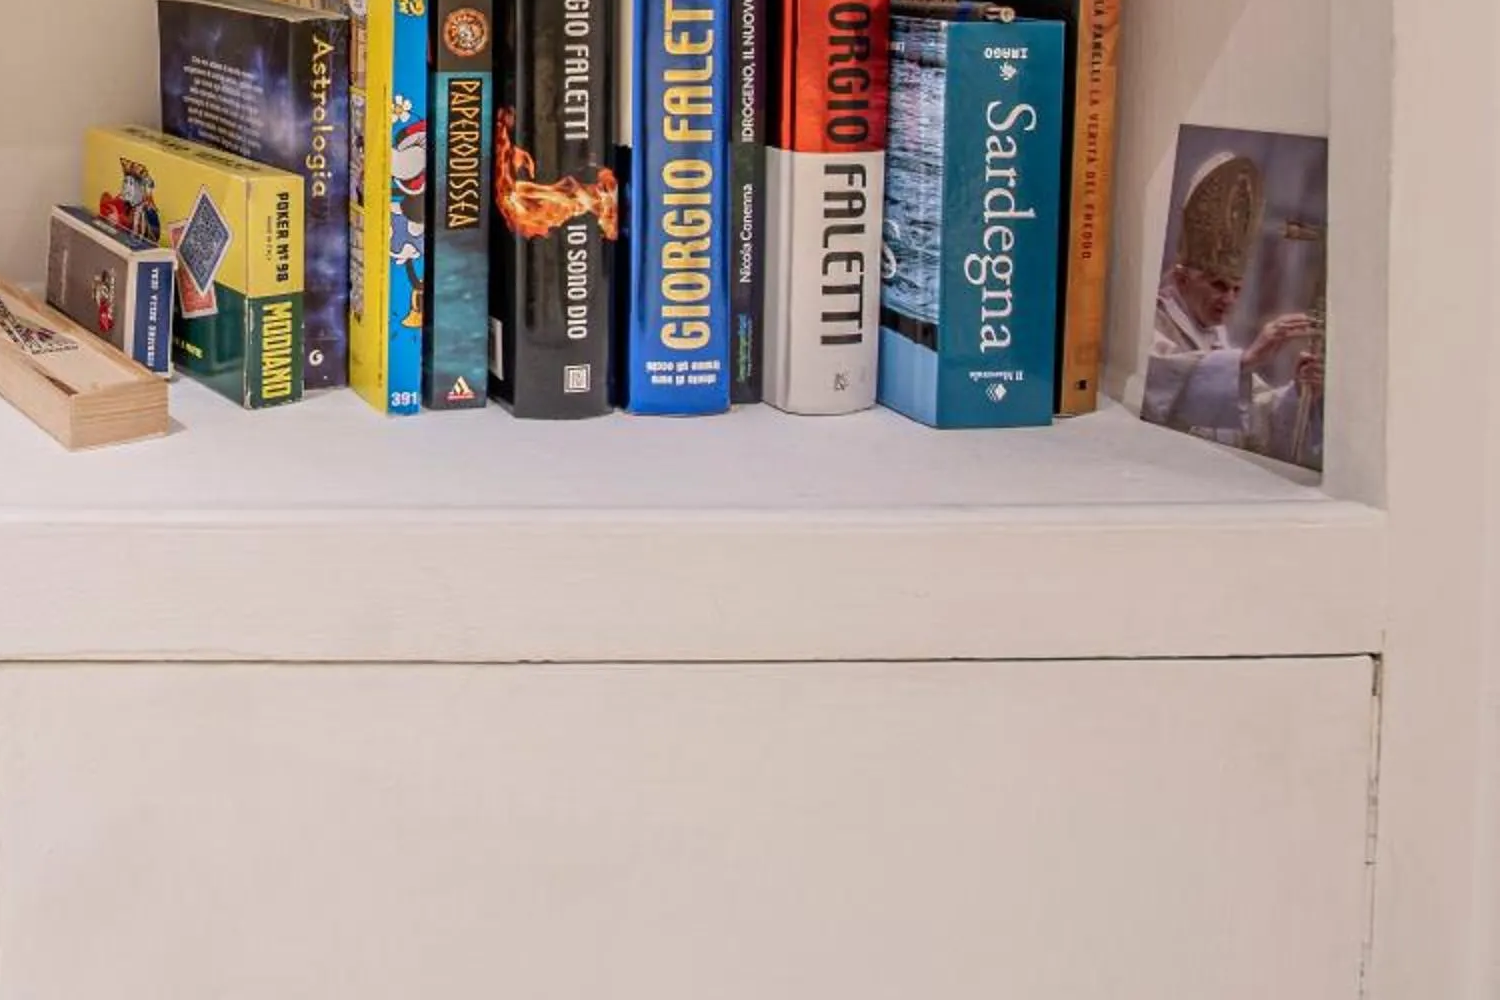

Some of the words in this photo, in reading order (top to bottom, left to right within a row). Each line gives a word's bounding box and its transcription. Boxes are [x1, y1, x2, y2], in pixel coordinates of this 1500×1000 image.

[743, 45, 756, 60] IL
[306, 33, 335, 197] Astrologia
[564, 44, 589, 141] FALETTI
[741, 62, 756, 142] IDROGENO,
[448, 79, 481, 228] PAPERODISSEA
[276, 191, 290, 240] POKER
[566, 224, 587, 244] IO
[963, 101, 1037, 354] Sardegna
[276, 263, 289, 283] 98
[566, 250, 588, 301] SONO
[660, 159, 713, 351] GIORGIO
[739, 243, 753, 284] Nicola
[820, 162, 867, 345] FALETTI
[261, 301, 293, 400] MODIANO
[566, 305, 588, 340] DIO
[391, 391, 417, 407] 391
